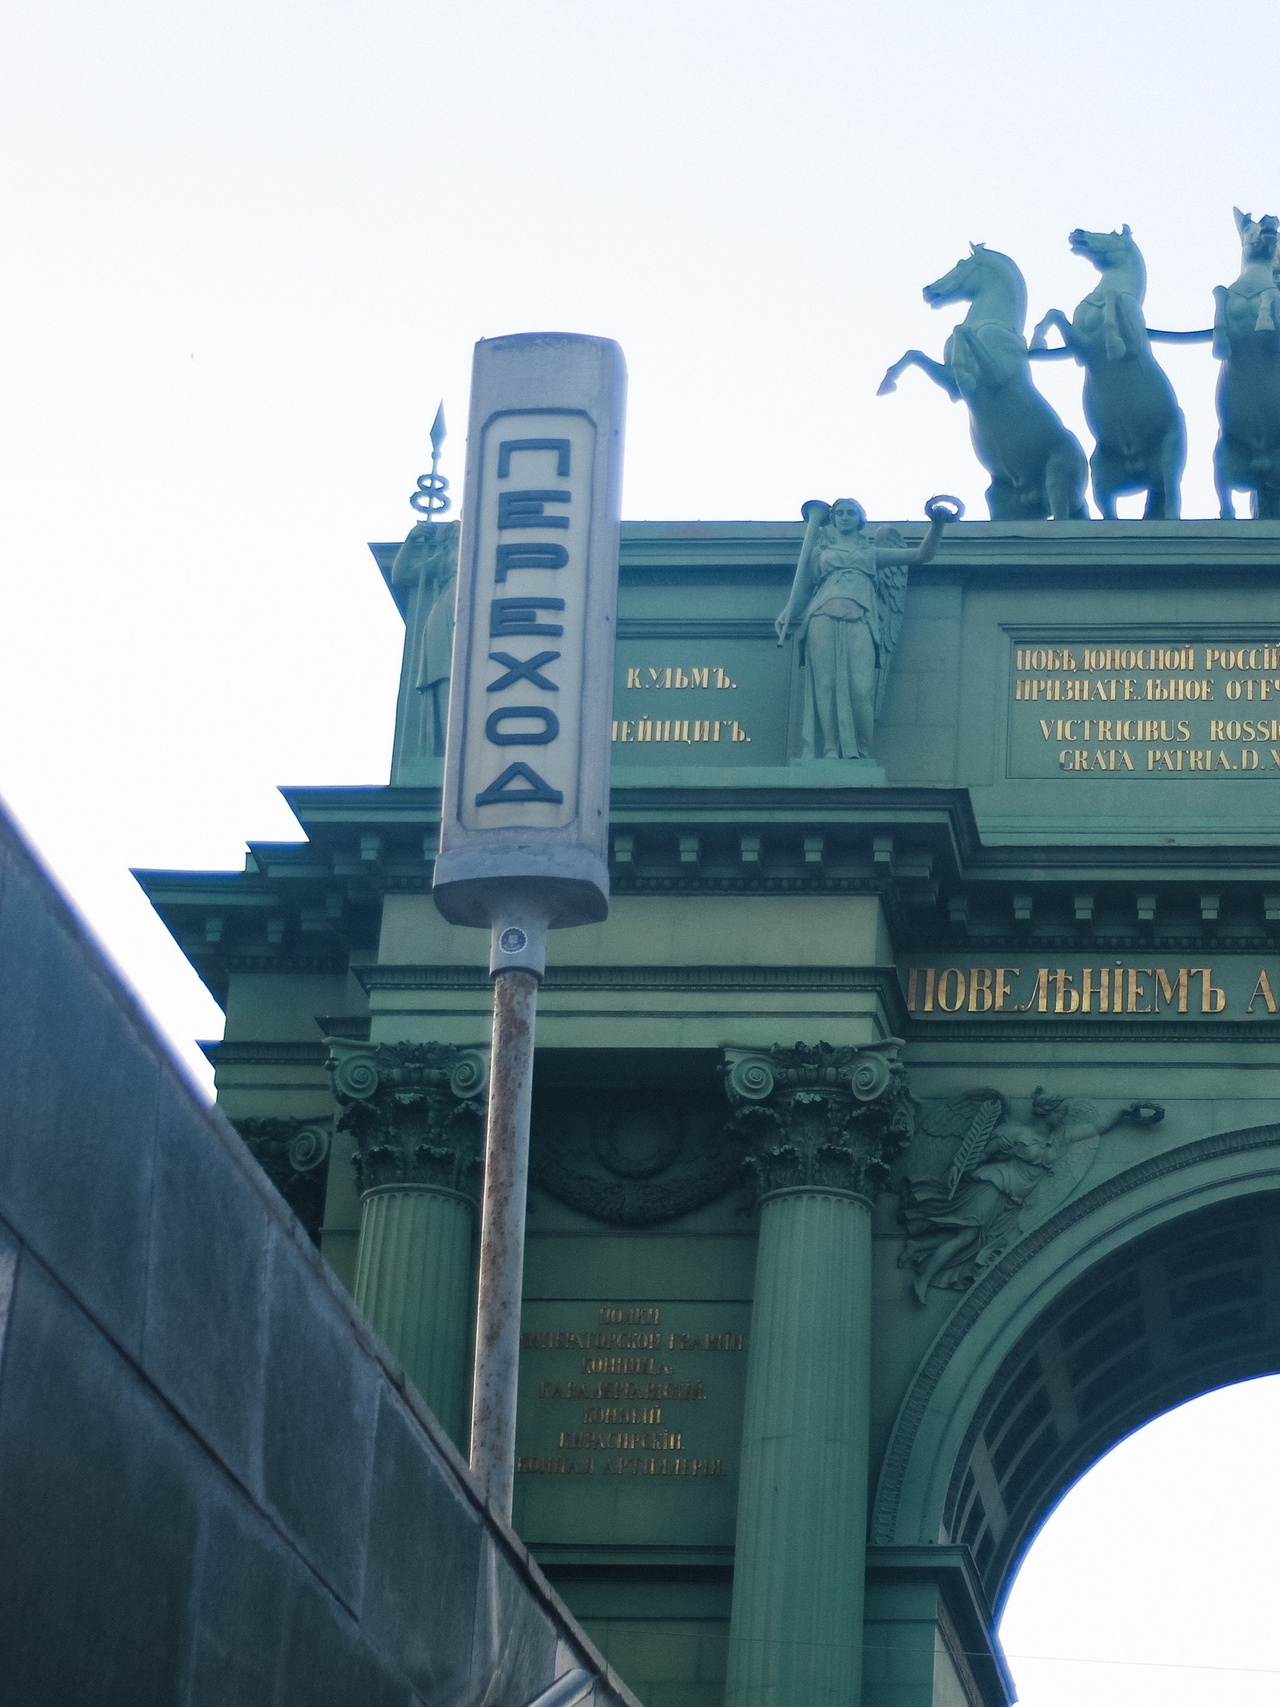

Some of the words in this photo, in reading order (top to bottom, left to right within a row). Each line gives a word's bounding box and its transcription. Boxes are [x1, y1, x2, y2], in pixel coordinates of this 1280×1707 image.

[475, 437, 572, 808] ПЕРЕХОД
[627, 667, 738, 689] КУЛЬМЪ.
[1015, 679, 1214, 701] ПРИЗНАТЕЛЬНОЕ
[1039, 719, 1191, 742] VICTRICIBUS
[1059, 750, 1135, 771] GRATA
